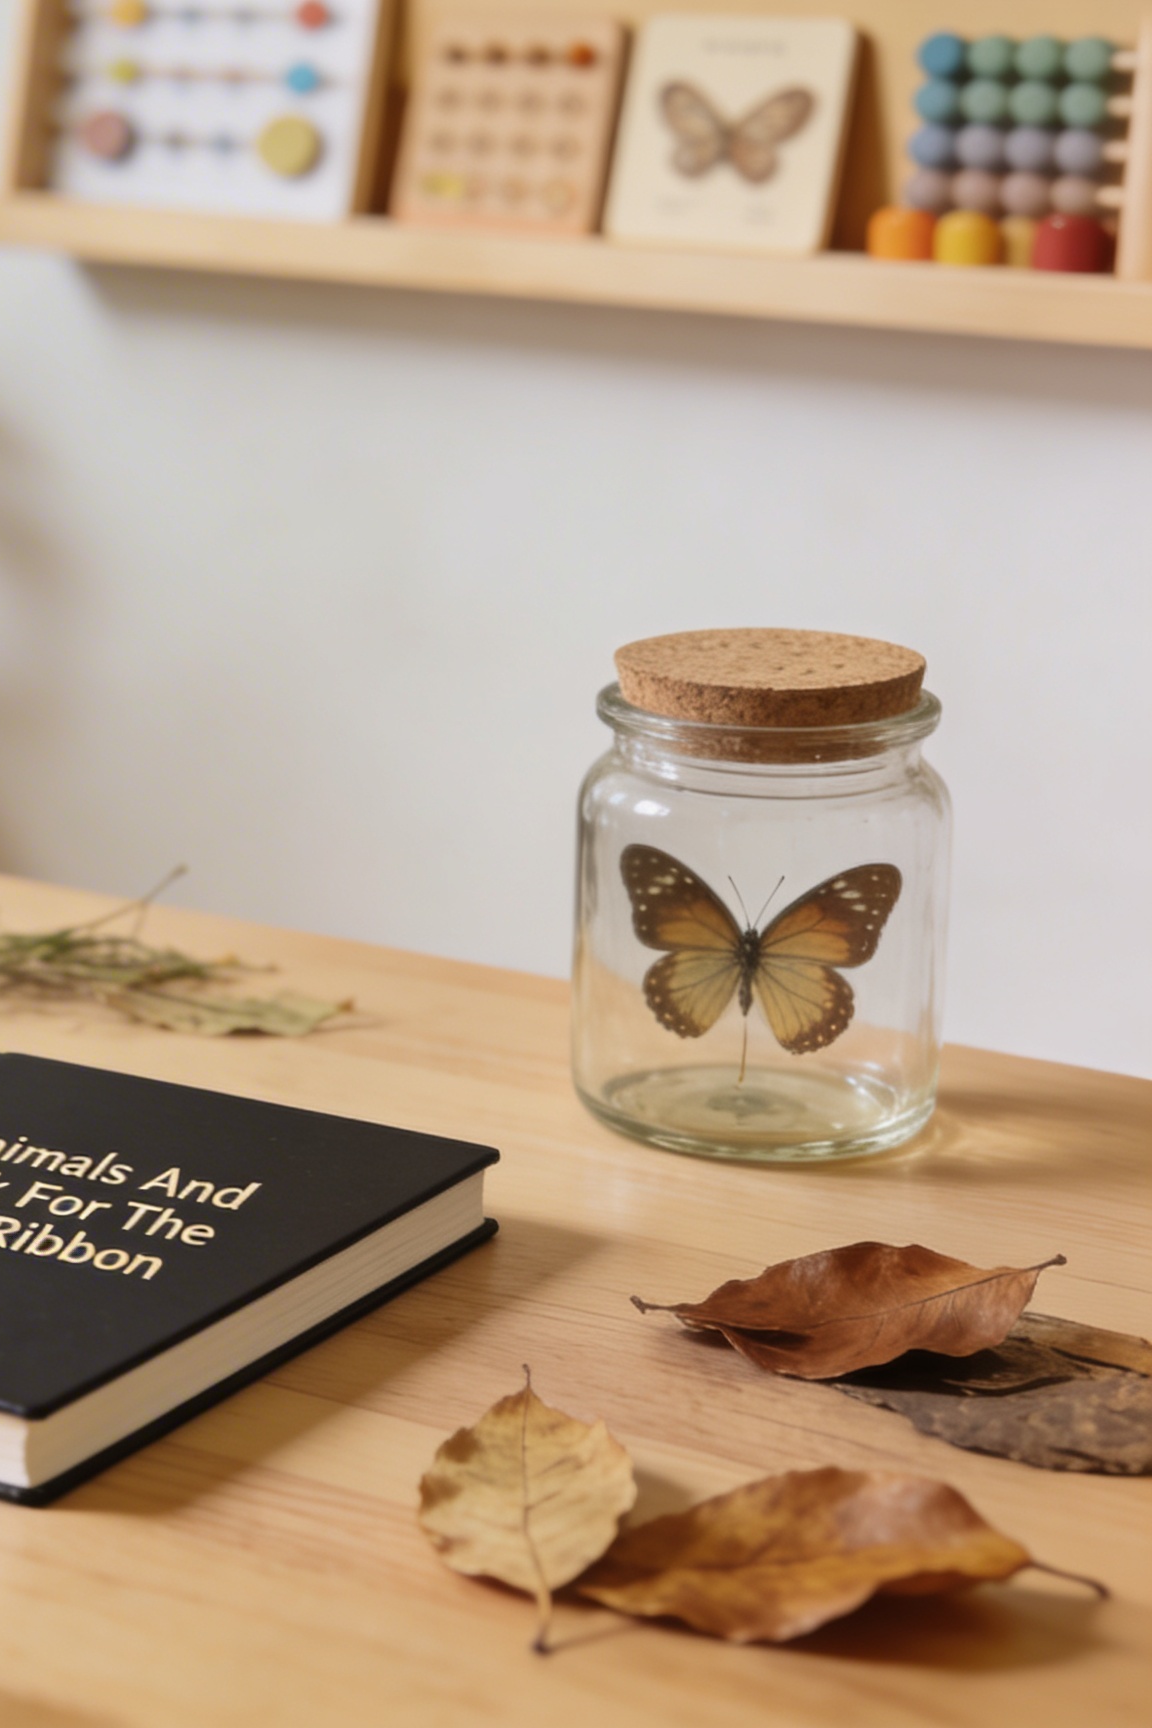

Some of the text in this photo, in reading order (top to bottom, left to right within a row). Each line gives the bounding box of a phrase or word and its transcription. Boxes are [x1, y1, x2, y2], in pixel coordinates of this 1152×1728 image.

[14, 1180, 113, 1221] For
[121, 1200, 216, 1246] The
[137, 1167, 263, 1211] And
